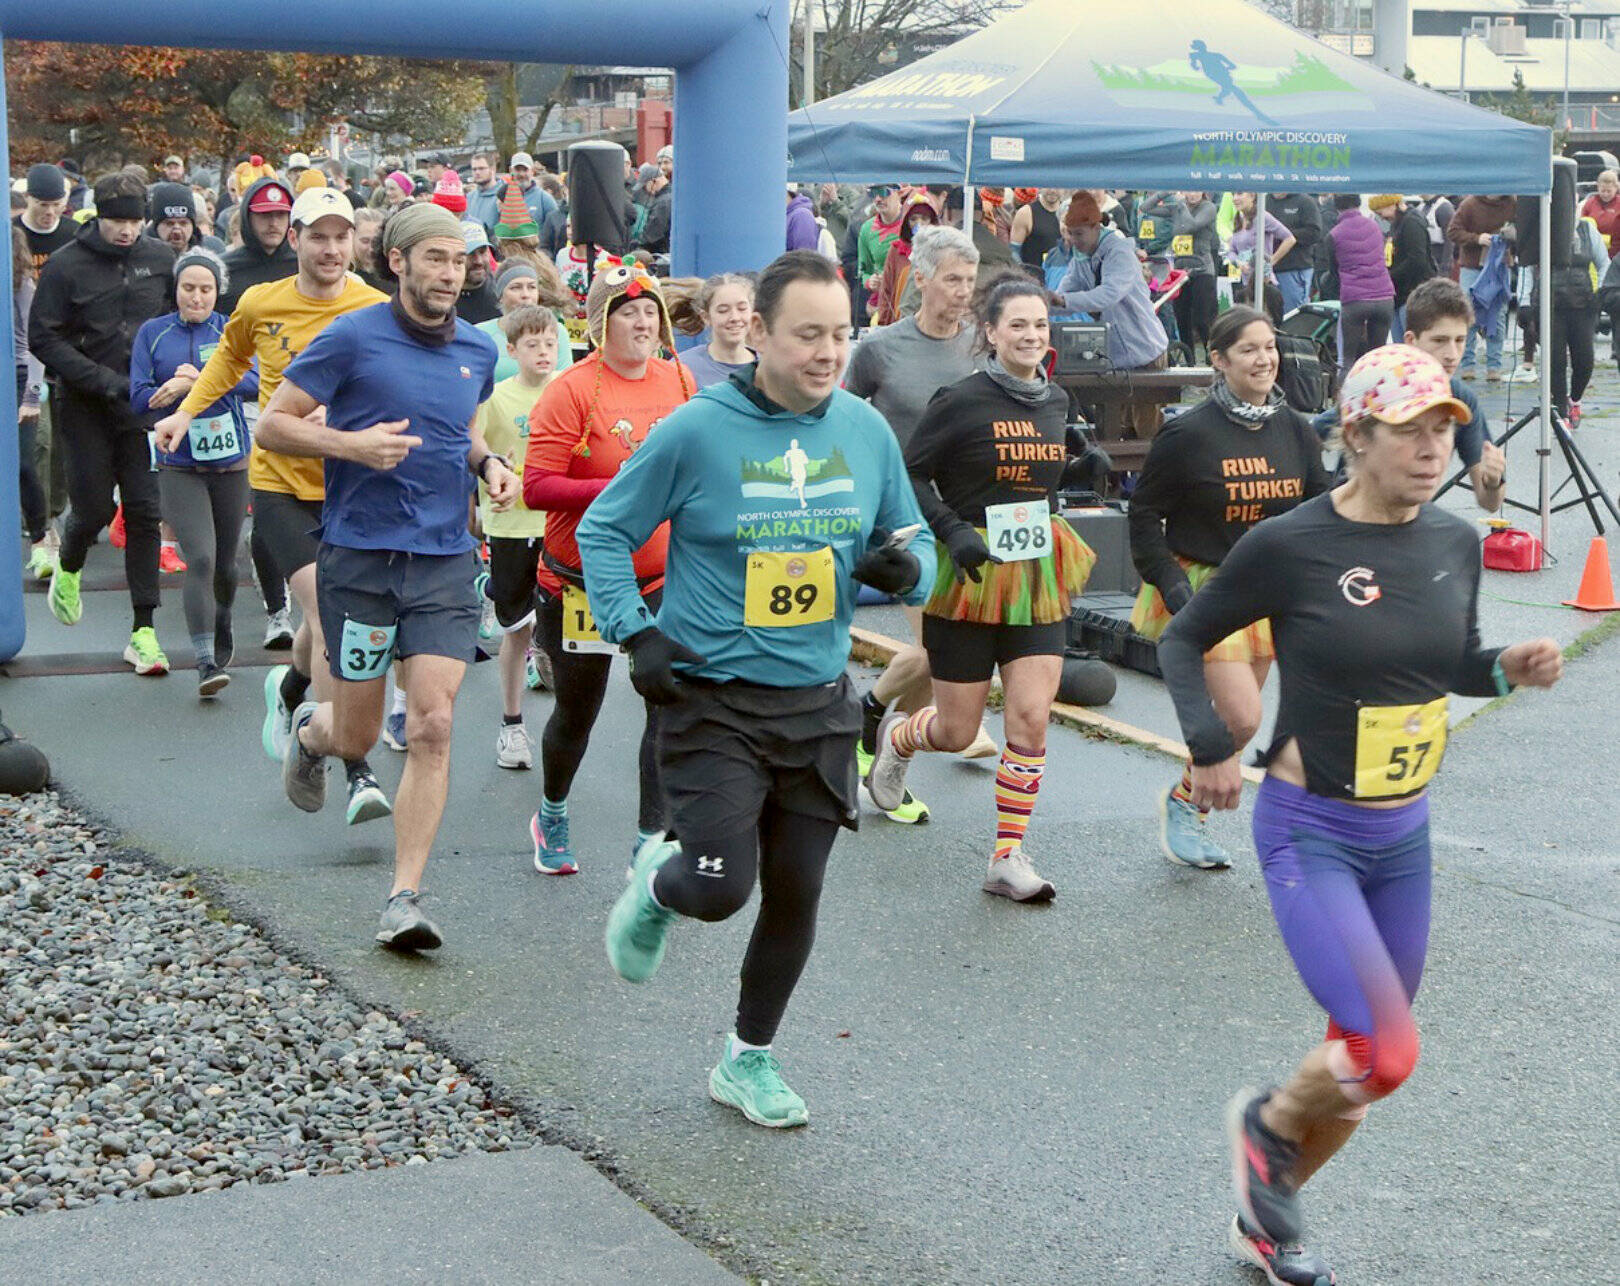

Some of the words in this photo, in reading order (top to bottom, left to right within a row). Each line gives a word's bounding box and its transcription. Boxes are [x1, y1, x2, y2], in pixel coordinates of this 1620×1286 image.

[1235, 131, 1284, 142] OLYMPIC
[1286, 132, 1347, 144] DISCOVERY
[1189, 144, 1351, 169] MARATHON
[992, 420, 1042, 438] RUN.
[196, 431, 234, 453] 448
[996, 465, 1032, 482] PIE.
[1222, 456, 1276, 477] RUN.
[736, 512, 771, 521] NORTH
[771, 509, 811, 520] OLYMPIC
[736, 518, 862, 539] MARATHON
[997, 525, 1046, 551] 498
[769, 583, 818, 616] 89
[347, 647, 394, 672] 37
[1386, 740, 1434, 782] 57
